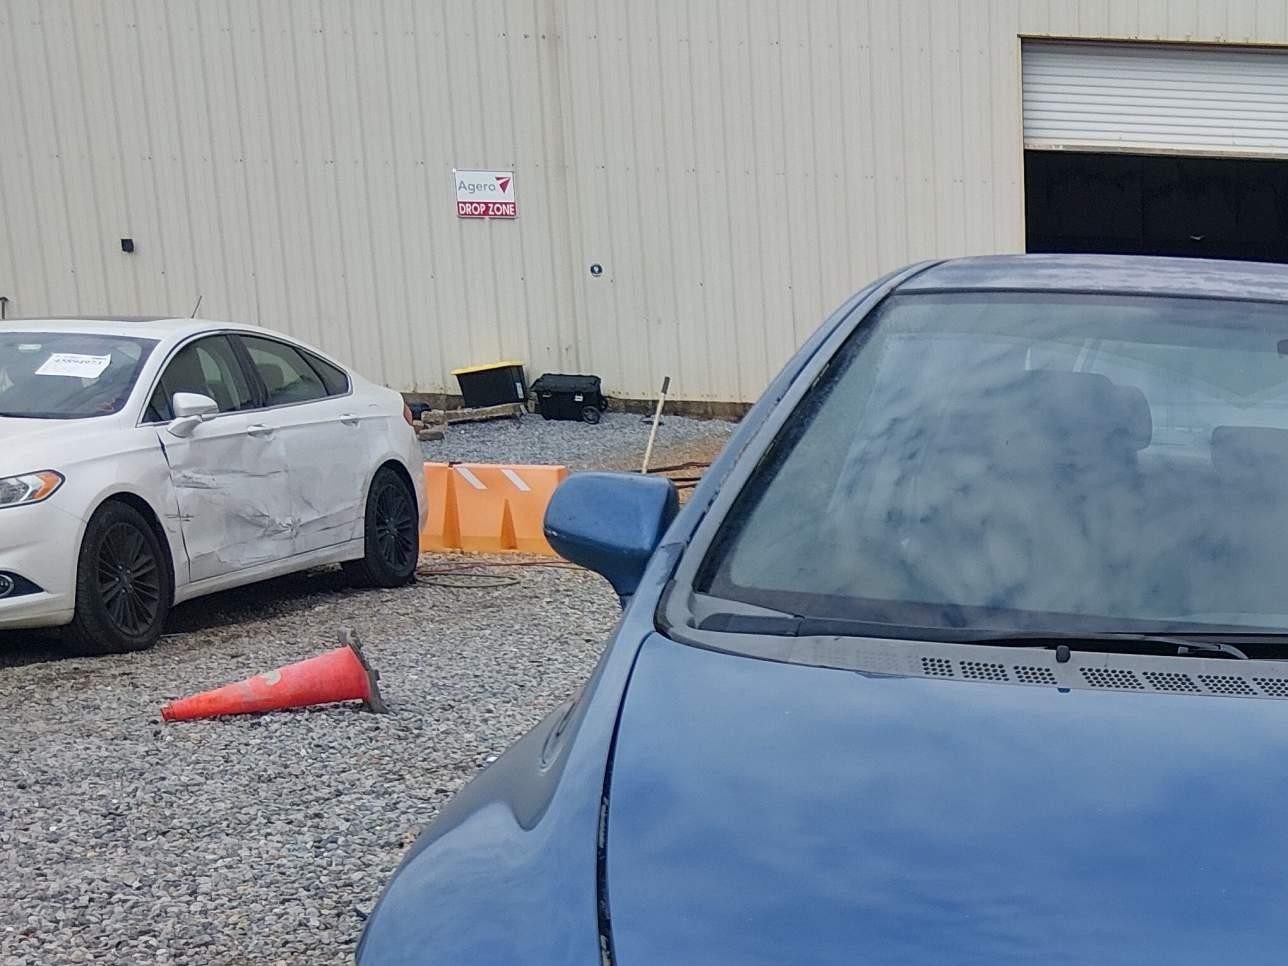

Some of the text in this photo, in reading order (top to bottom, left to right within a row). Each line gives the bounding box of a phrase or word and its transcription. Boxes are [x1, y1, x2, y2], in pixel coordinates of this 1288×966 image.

[458, 180, 496, 194] Agero
[458, 203, 515, 215] DROP ZONE
